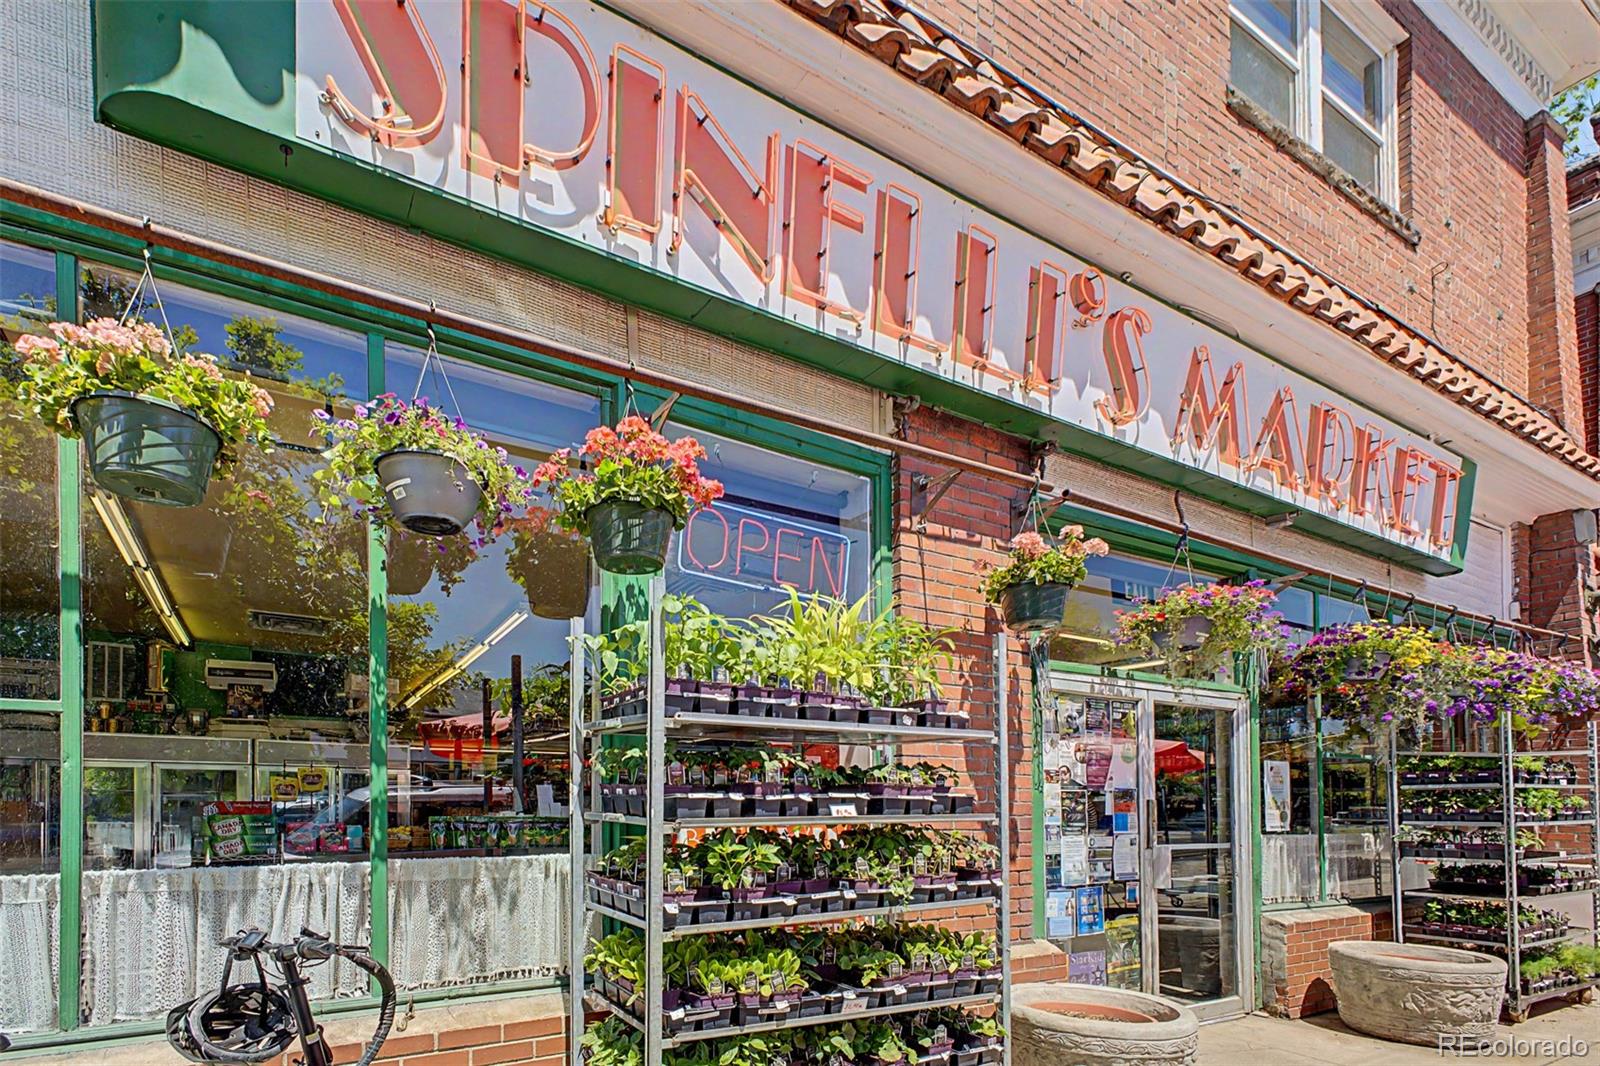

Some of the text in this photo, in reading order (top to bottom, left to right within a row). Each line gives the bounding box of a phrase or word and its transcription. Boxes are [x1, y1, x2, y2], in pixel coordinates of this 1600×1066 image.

[322, 0, 1465, 549] SPINELLI'S MARKET
[686, 506, 845, 597] OPEN
[210, 819, 244, 832] CANADA
[221, 827, 238, 835] DRY
[212, 839, 246, 852] CANADA
[223, 847, 239, 855] DRY
